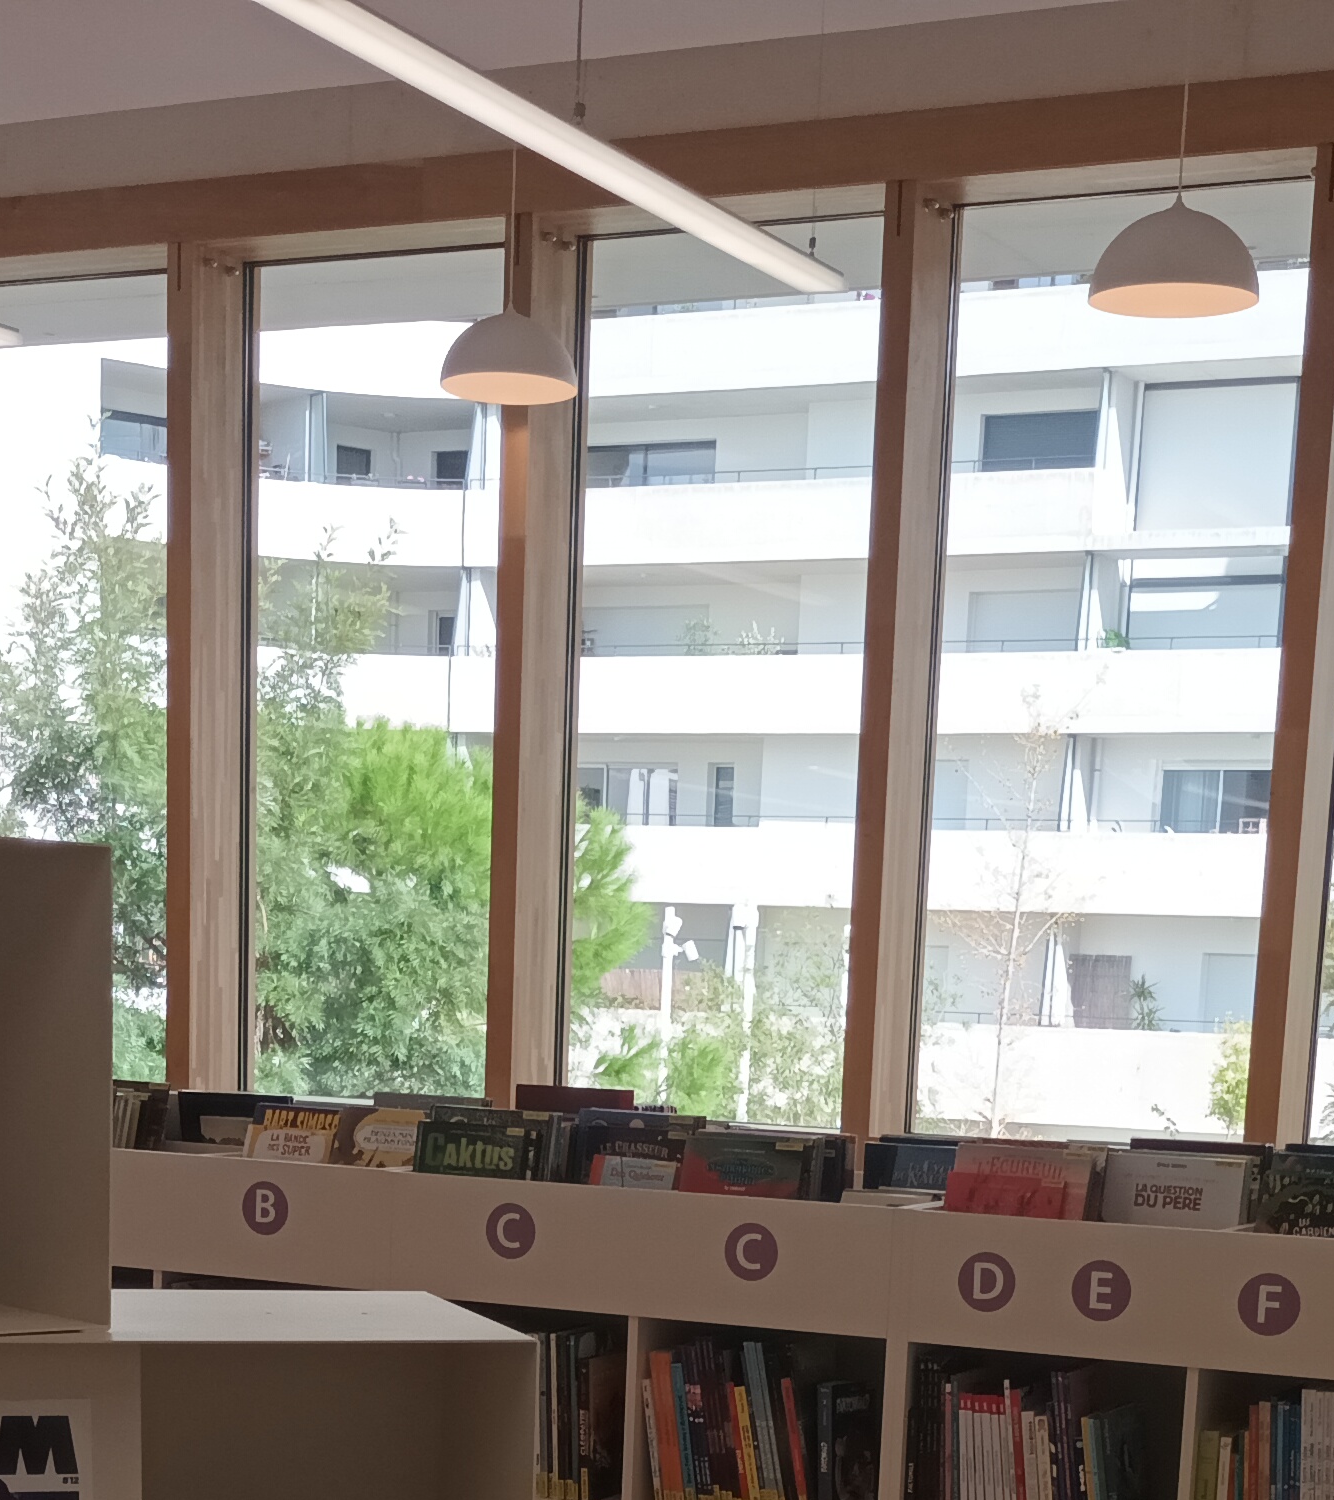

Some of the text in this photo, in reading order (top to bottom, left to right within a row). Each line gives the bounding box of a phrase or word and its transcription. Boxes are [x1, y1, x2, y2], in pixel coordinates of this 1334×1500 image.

[296, 1111, 341, 1132] SIMPSO
[280, 1144, 311, 1157] SUPER
[254, 1189, 276, 1223] B
[1134, 1193, 1158, 1208] DU
[1136, 1183, 1203, 1197] LA QUESTION
[496, 1213, 521, 1249] C
[736, 1232, 763, 1270] C
[972, 1262, 1004, 1300] D
[1089, 1271, 1113, 1310] E
[1256, 1284, 1283, 1324] F
